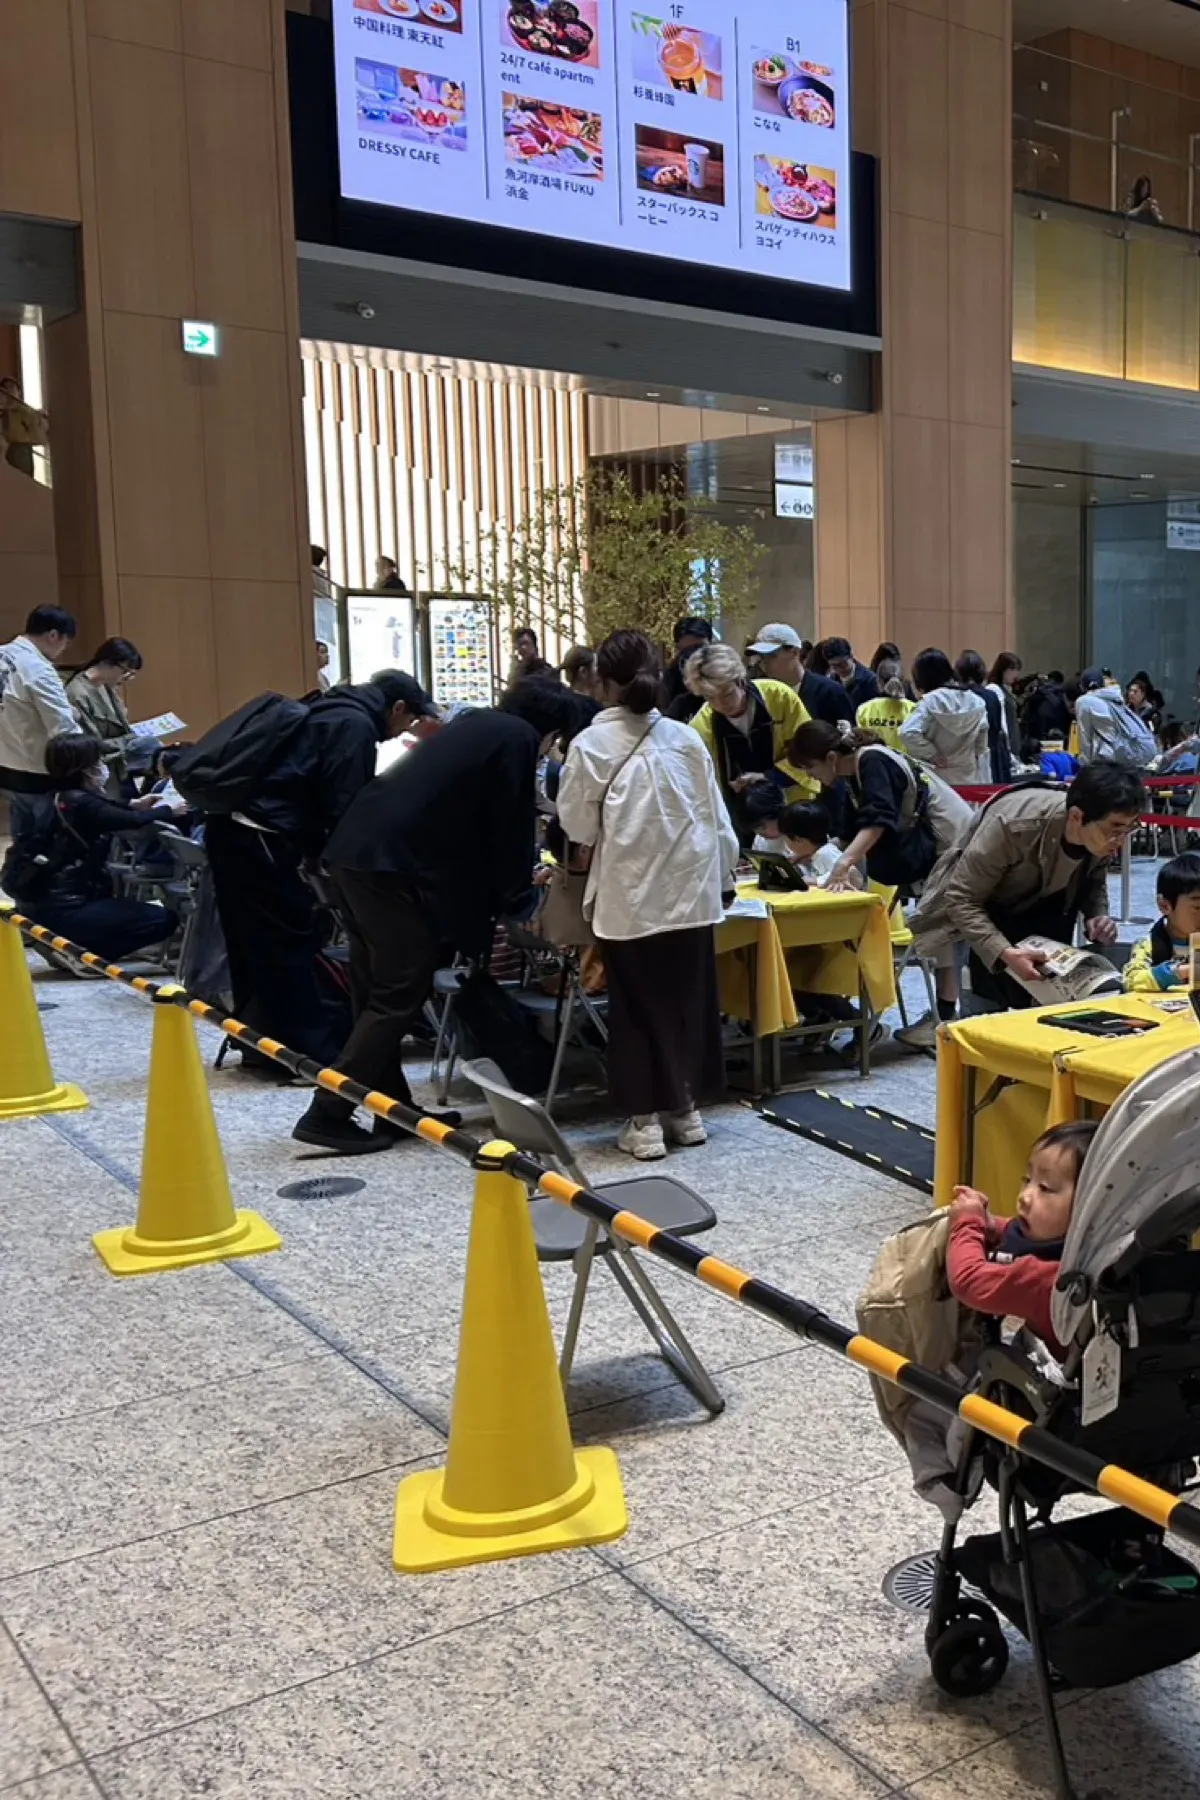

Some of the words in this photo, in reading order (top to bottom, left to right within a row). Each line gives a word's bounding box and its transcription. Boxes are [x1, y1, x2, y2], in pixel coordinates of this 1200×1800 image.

[669, 3, 685, 19] 1F
[353, 16, 404, 39] 中国料理
[786, 36, 800, 53] B1
[500, 51, 526, 68] 24/7
[527, 60, 552, 75] café
[553, 66, 595, 85] apartm
[500, 71, 522, 84] ent
[358, 137, 407, 157] DRESSY
[408, 148, 441, 165] CAFE
[563, 180, 595, 197] FUKU
[756, 236, 782, 250] ヨコイ
